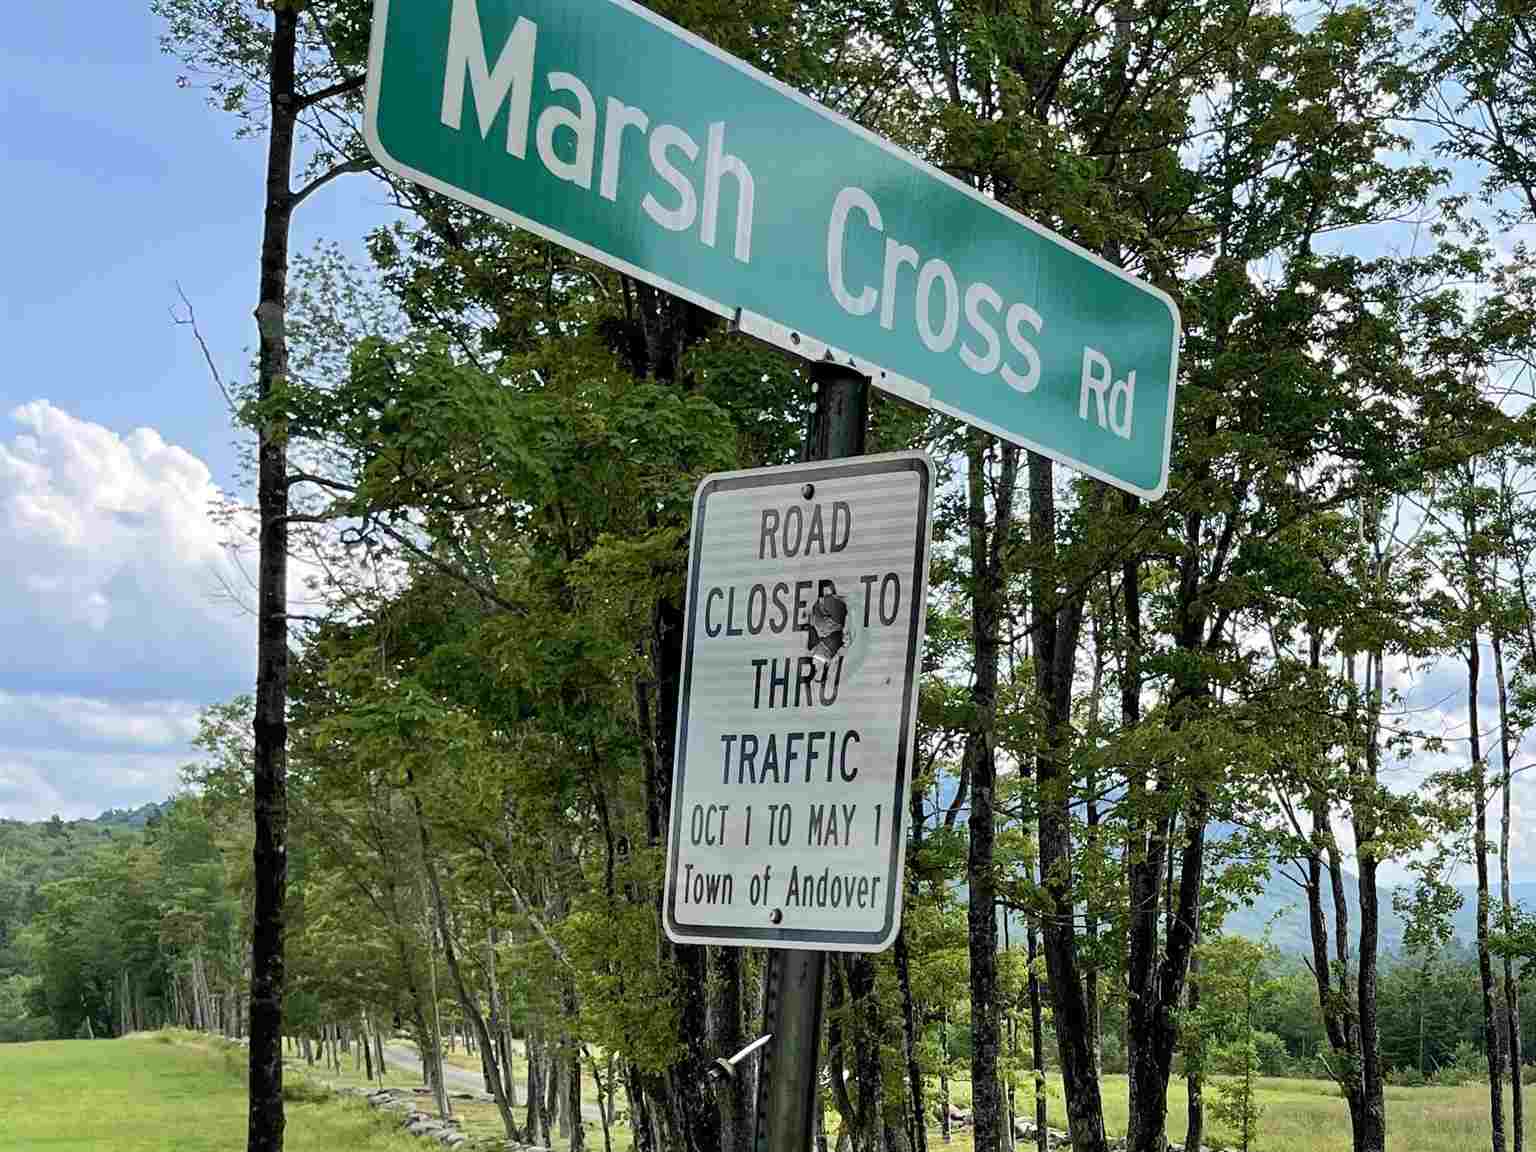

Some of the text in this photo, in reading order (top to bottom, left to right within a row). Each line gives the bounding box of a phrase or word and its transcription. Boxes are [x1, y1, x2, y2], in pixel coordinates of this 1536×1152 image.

[441, 0, 1136, 441] Marsh Cross Rd
[759, 501, 851, 560] ROAD
[860, 572, 900, 628] TO
[751, 655, 844, 709] THRU
[721, 730, 860, 784] TRAFFIC
[691, 803, 882, 846] OCT 1 TO MAY 1
[685, 864, 880, 909] Town of Andover
